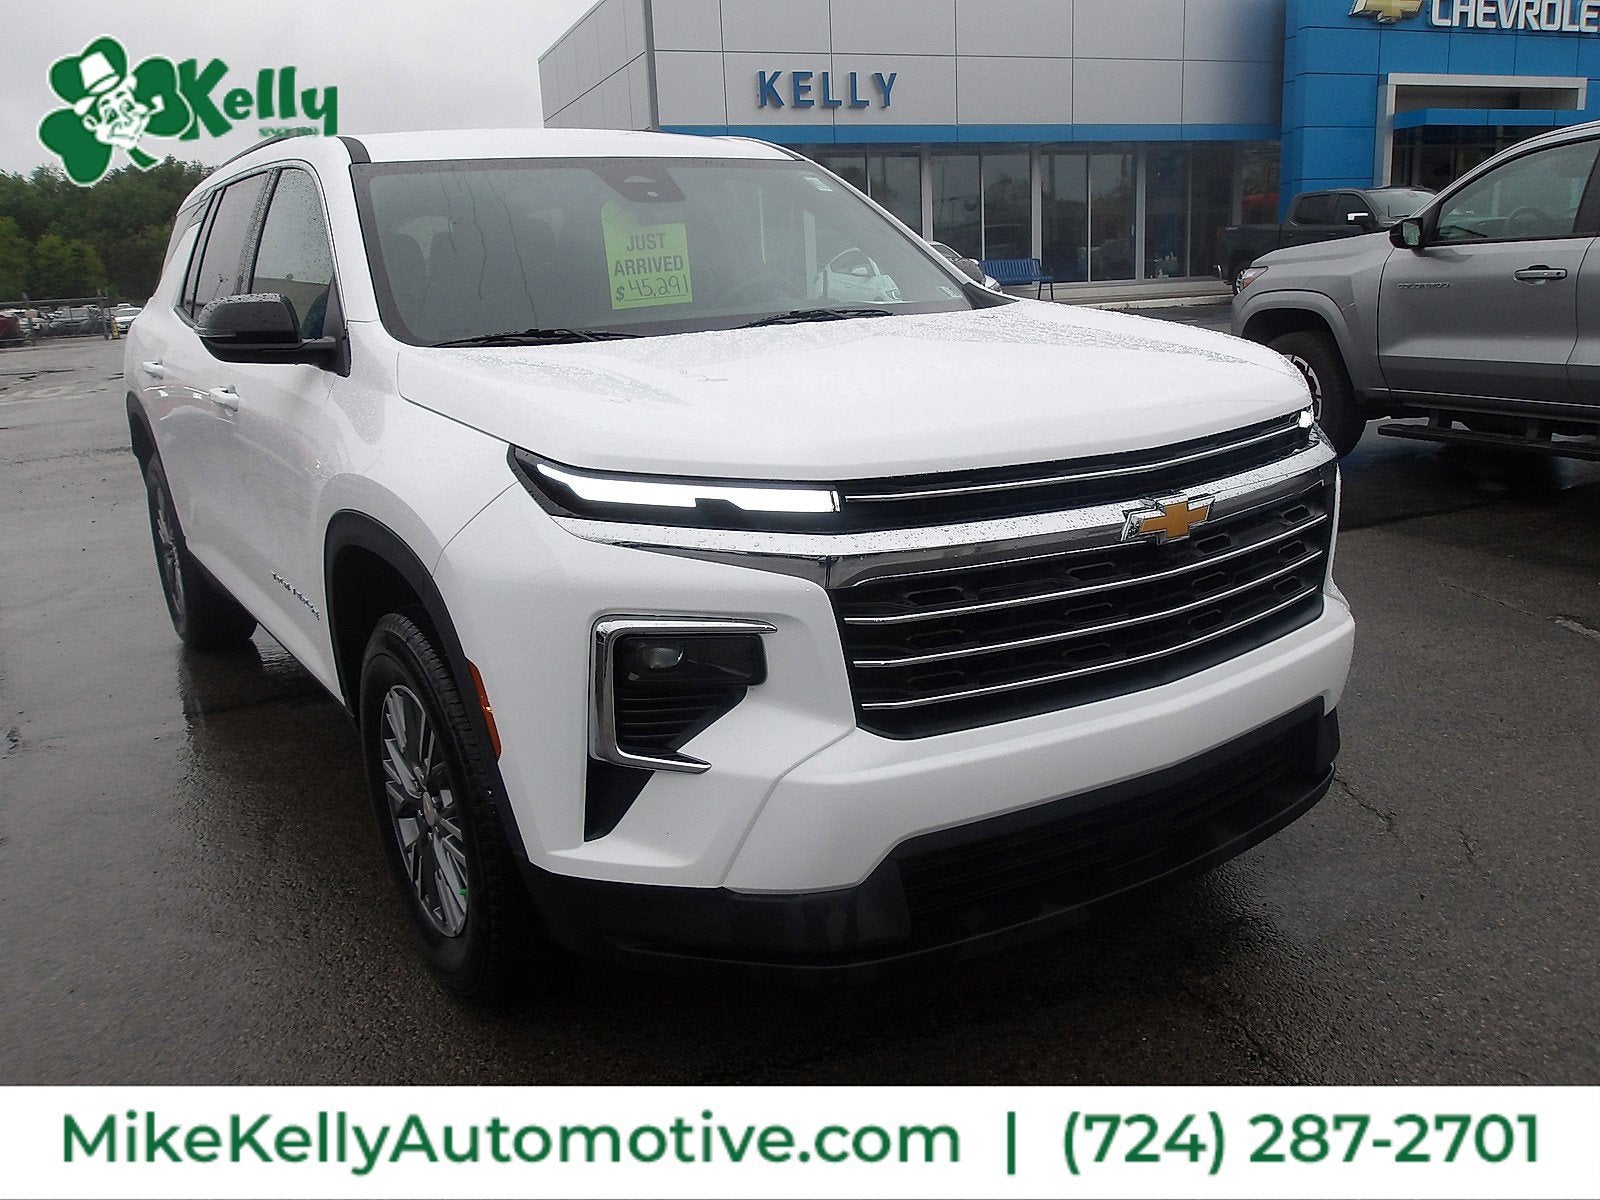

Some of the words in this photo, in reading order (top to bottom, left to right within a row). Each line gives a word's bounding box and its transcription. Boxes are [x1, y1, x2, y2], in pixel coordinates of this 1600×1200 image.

[757, 70, 898, 109] KELLY
[626, 232, 666, 252] JUST
[614, 255, 684, 277] ARRIVED
